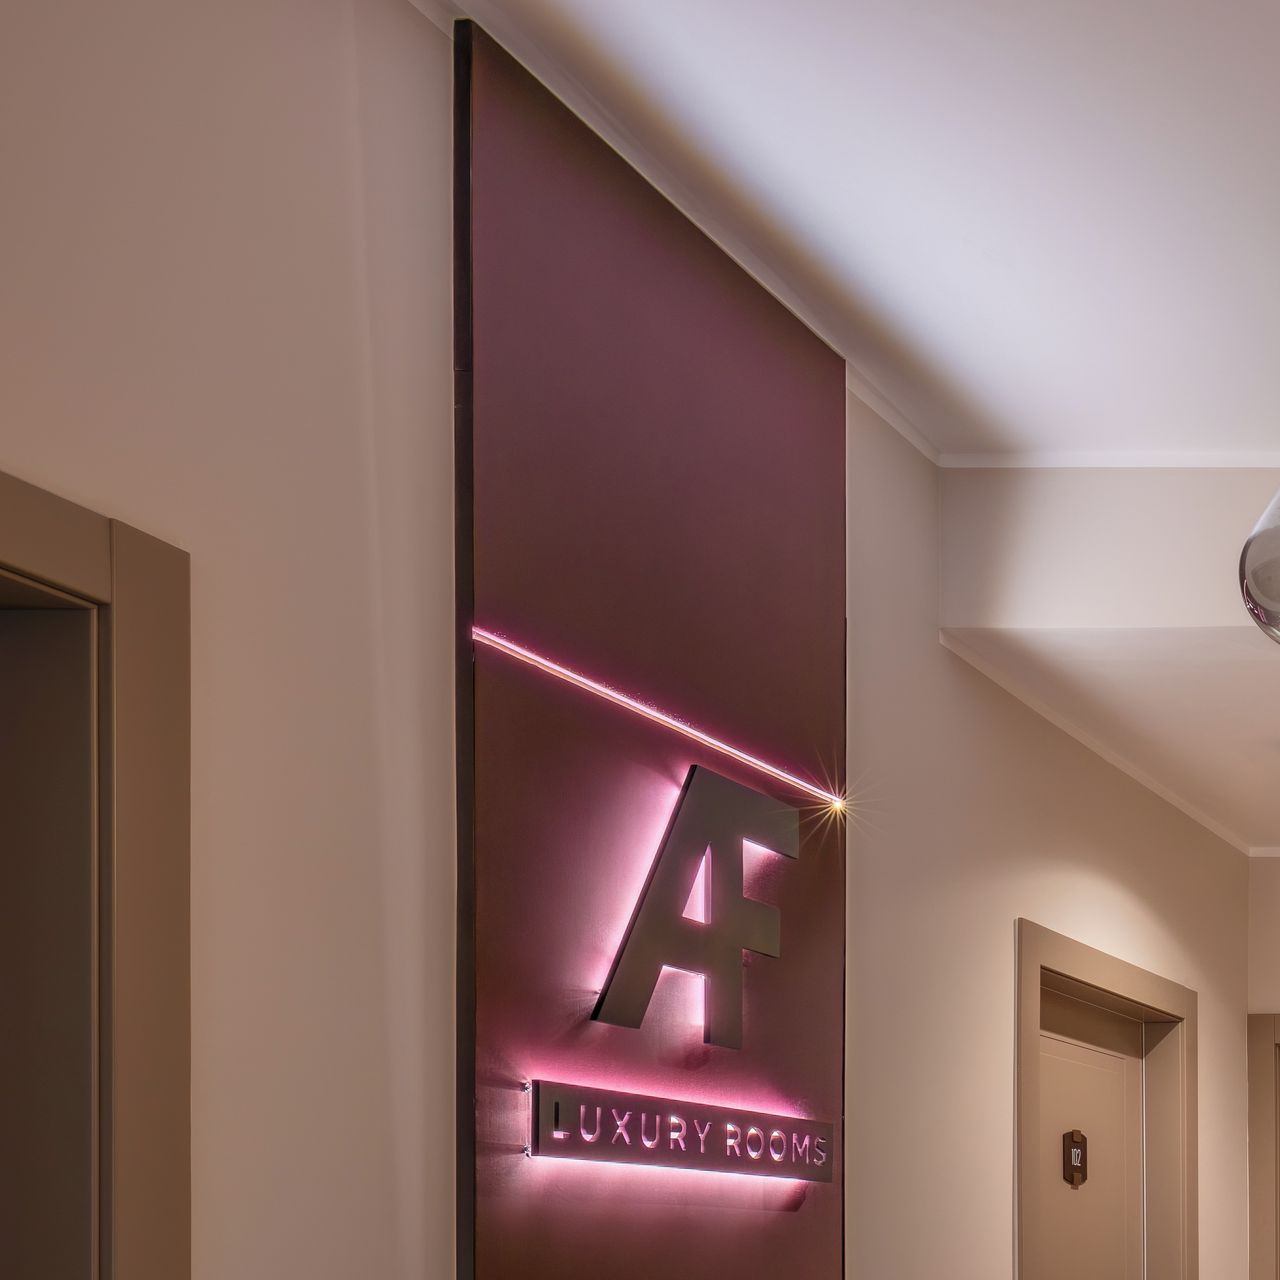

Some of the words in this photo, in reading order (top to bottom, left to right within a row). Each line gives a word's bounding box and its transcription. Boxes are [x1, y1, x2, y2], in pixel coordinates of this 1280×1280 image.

[590, 764, 800, 1050] AF
[553, 1101, 712, 1154] LUXURY
[727, 1123, 827, 1167] ROOMS
[1071, 1148, 1082, 1167] 102
